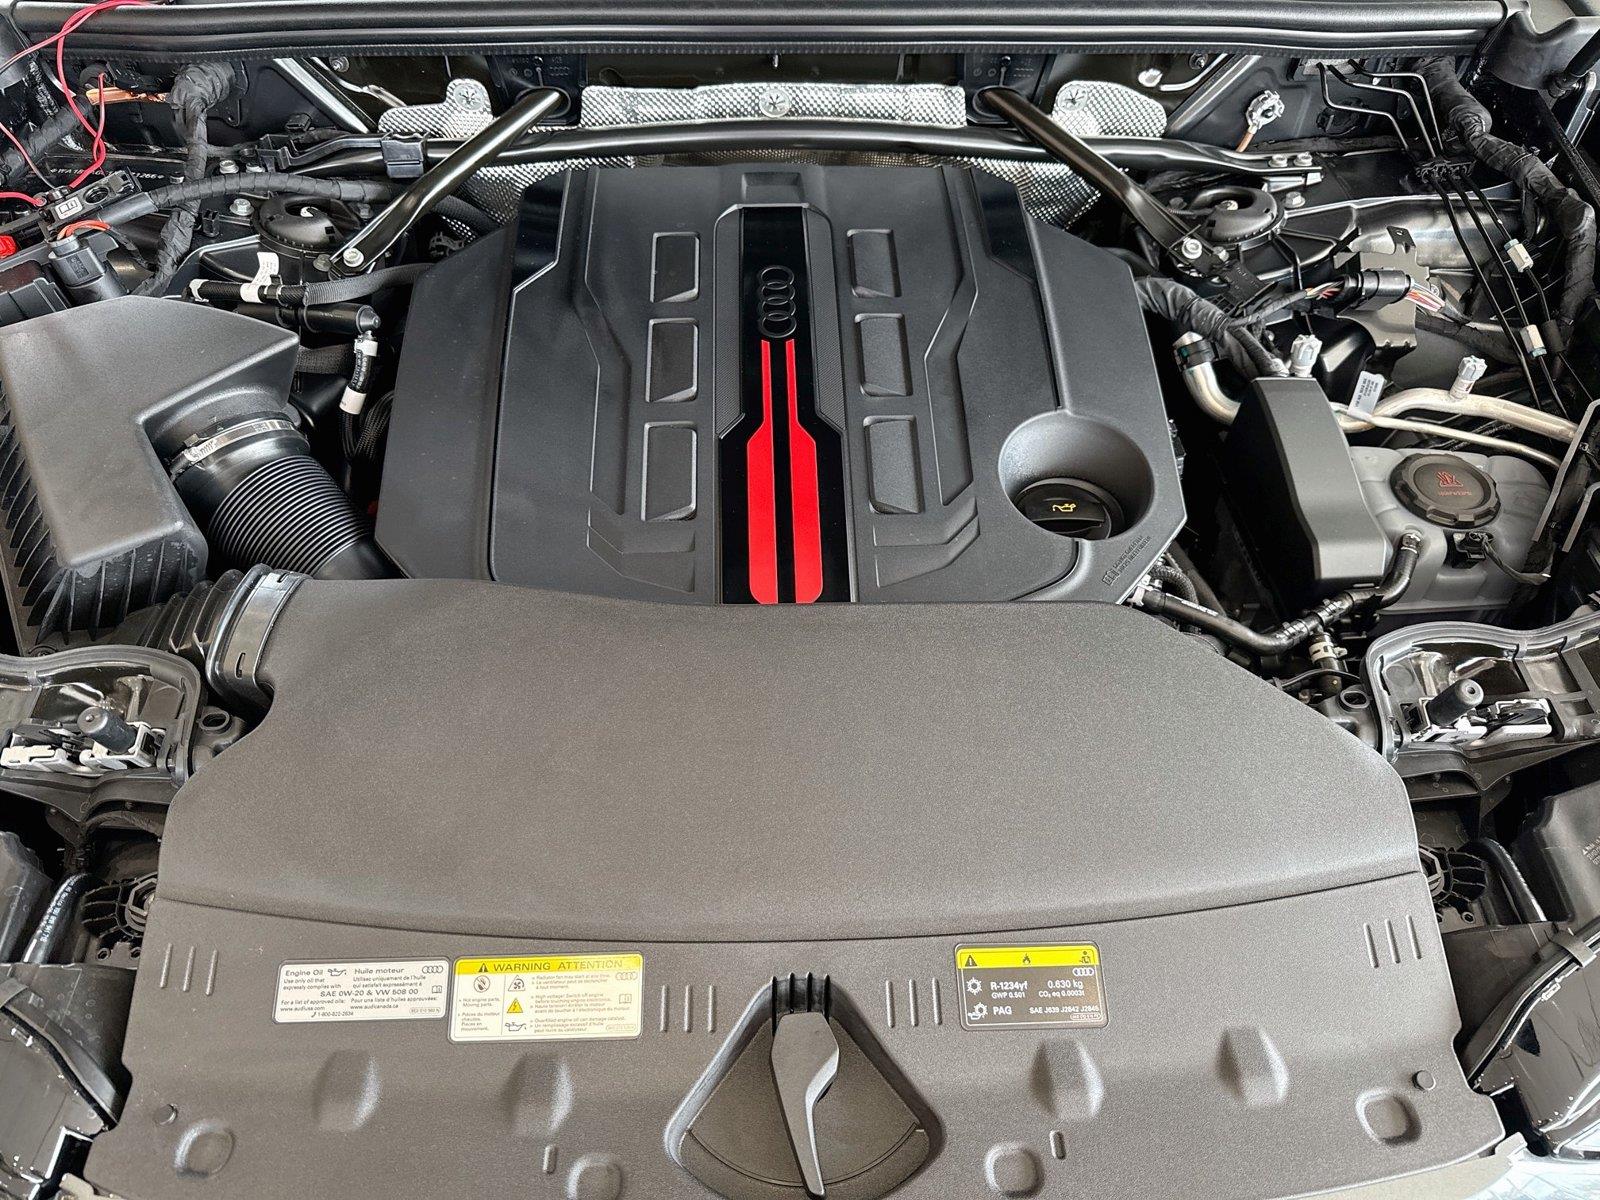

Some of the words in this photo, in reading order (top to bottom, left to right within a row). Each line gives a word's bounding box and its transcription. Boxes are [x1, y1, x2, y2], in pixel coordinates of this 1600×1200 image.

[494, 963, 550, 972] WARNING
[558, 960, 623, 970] ATTENTION
[990, 981, 1028, 991] R-1234yf
[1073, 979, 1083, 989] kg
[992, 1006, 1012, 1015] PAG
